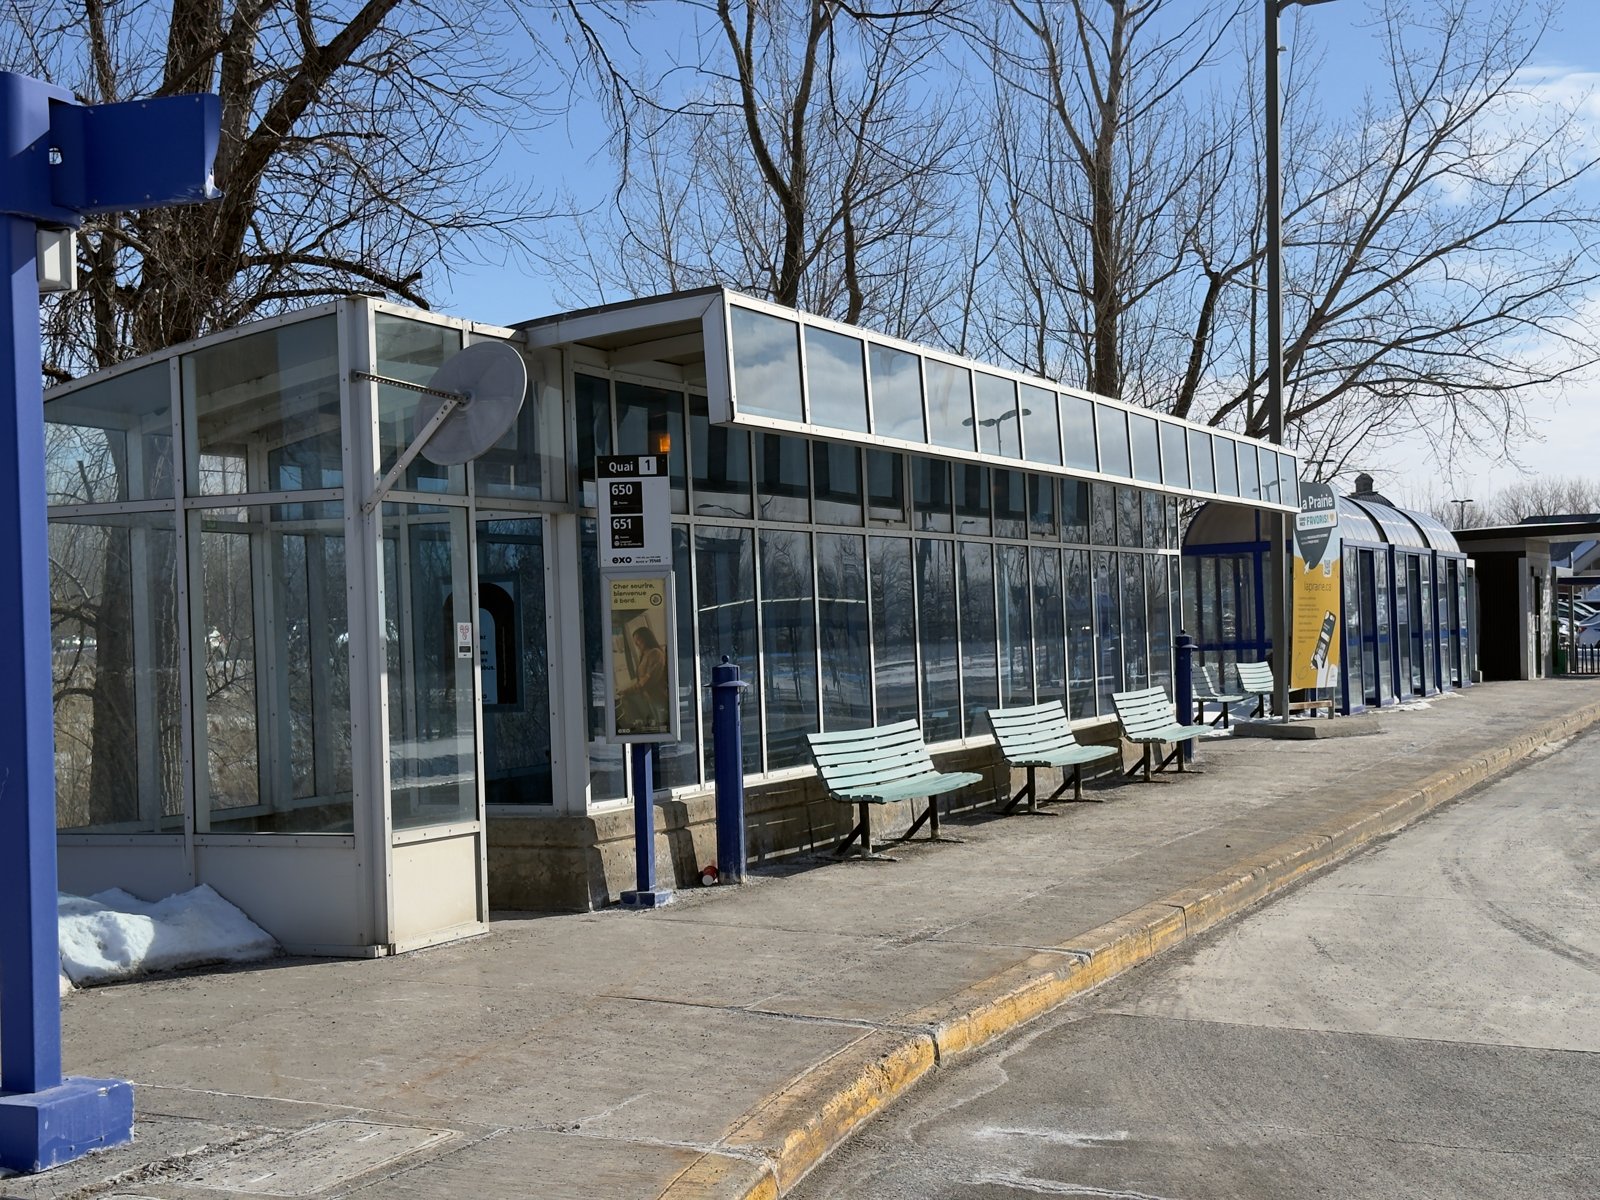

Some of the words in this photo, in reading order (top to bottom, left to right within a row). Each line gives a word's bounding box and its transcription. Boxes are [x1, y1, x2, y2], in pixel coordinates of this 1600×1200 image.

[608, 461, 634, 473] Quai
[644, 459, 651, 472] 1
[611, 484, 633, 496] 650
[1308, 494, 1333, 509] Prairie
[612, 518, 632, 530] 651
[611, 556, 632, 564] exo
